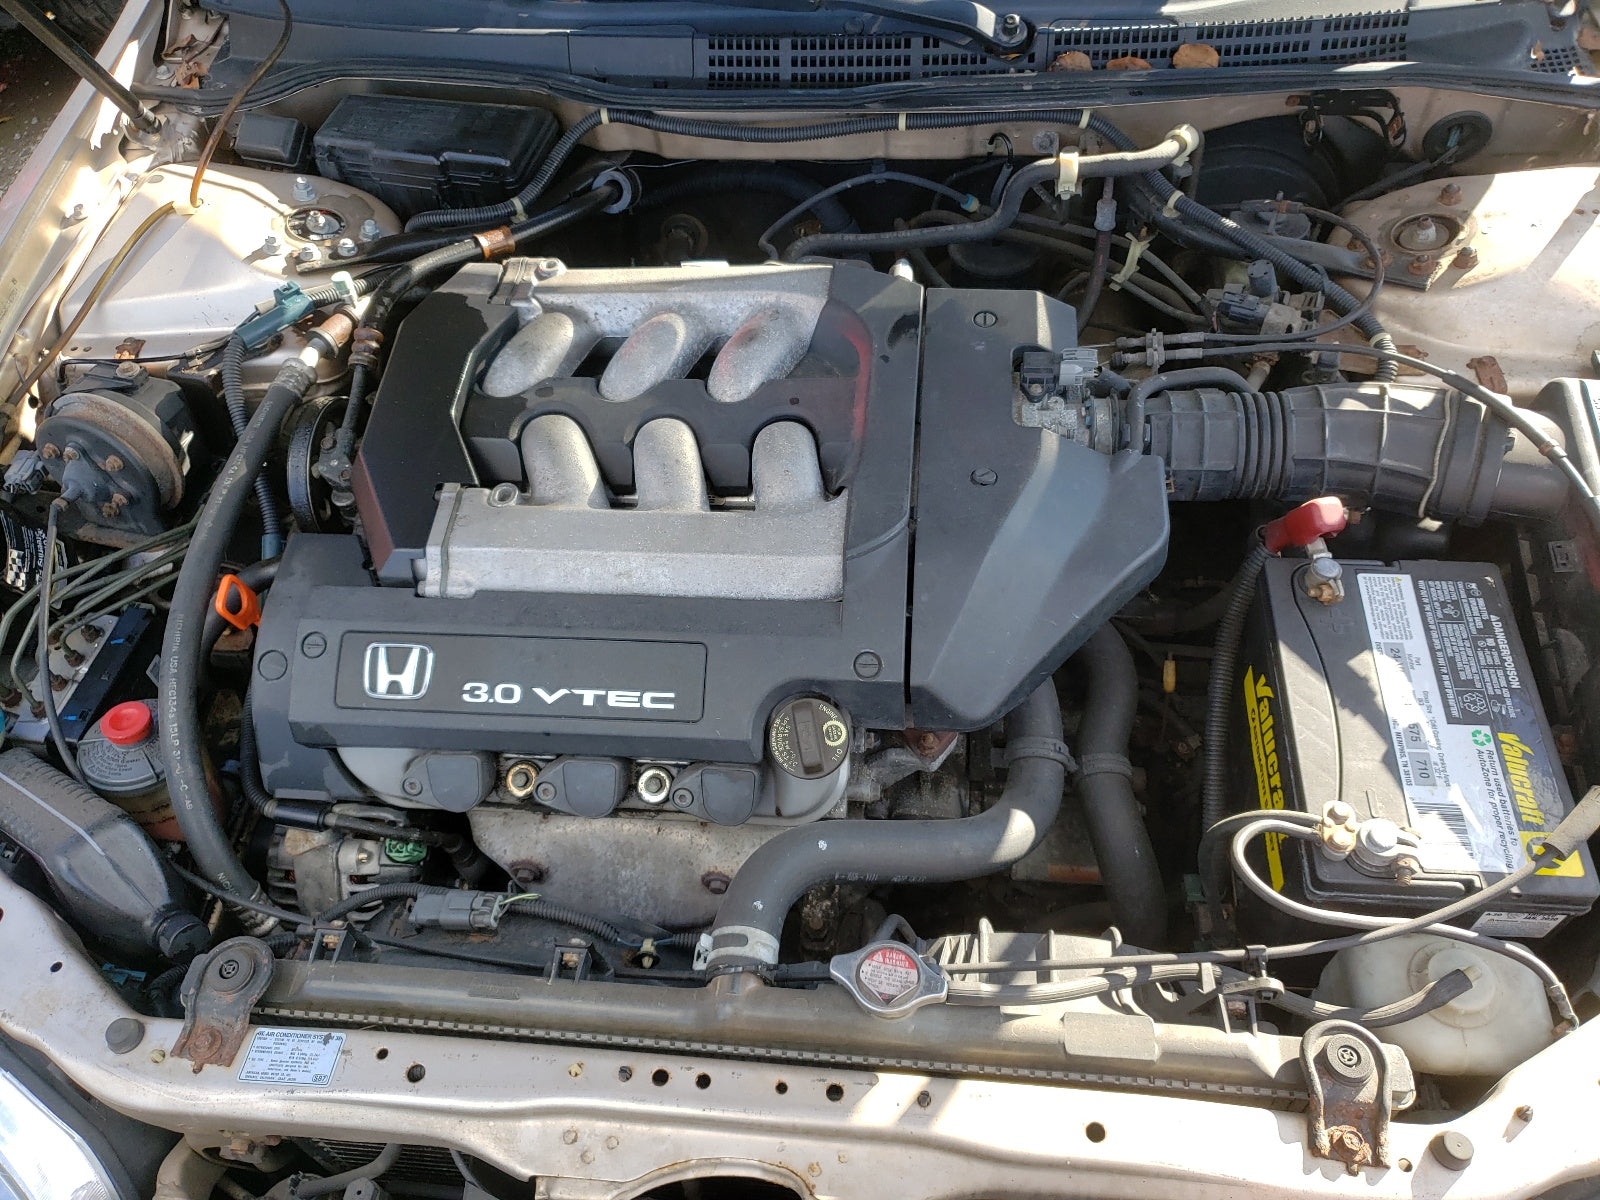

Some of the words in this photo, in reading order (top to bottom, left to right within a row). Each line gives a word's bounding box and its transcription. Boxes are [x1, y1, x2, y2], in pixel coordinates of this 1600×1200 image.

[169, 656, 179, 674] USA
[1493, 621, 1521, 689] DANGER/POISON
[462, 682, 522, 704] 3.0
[531, 687, 675, 710] VTEC
[819, 703, 838, 720] ENGINE
[777, 726, 785, 752] SERVICE
[1409, 723, 1422, 742] 575
[832, 748, 843, 762] OIL
[1394, 732, 1405, 759] MEMPHIS,
[1401, 760, 1409, 768] TN
[1416, 760, 1430, 779] 710
[1437, 752, 1449, 774] Cranking
[1476, 748, 1494, 787] AutoZone
[1486, 750, 1500, 776] Return
[1492, 778, 1506, 798] used
[1497, 732, 1545, 826] Valucraft
[1487, 788, 1498, 800] for
[1488, 801, 1504, 829] proper
[1498, 799, 1517, 836] batteries
[1497, 831, 1515, 870] recycling
[1509, 838, 1519, 846] to
[275, 1031, 312, 1040] CONDITIONER
